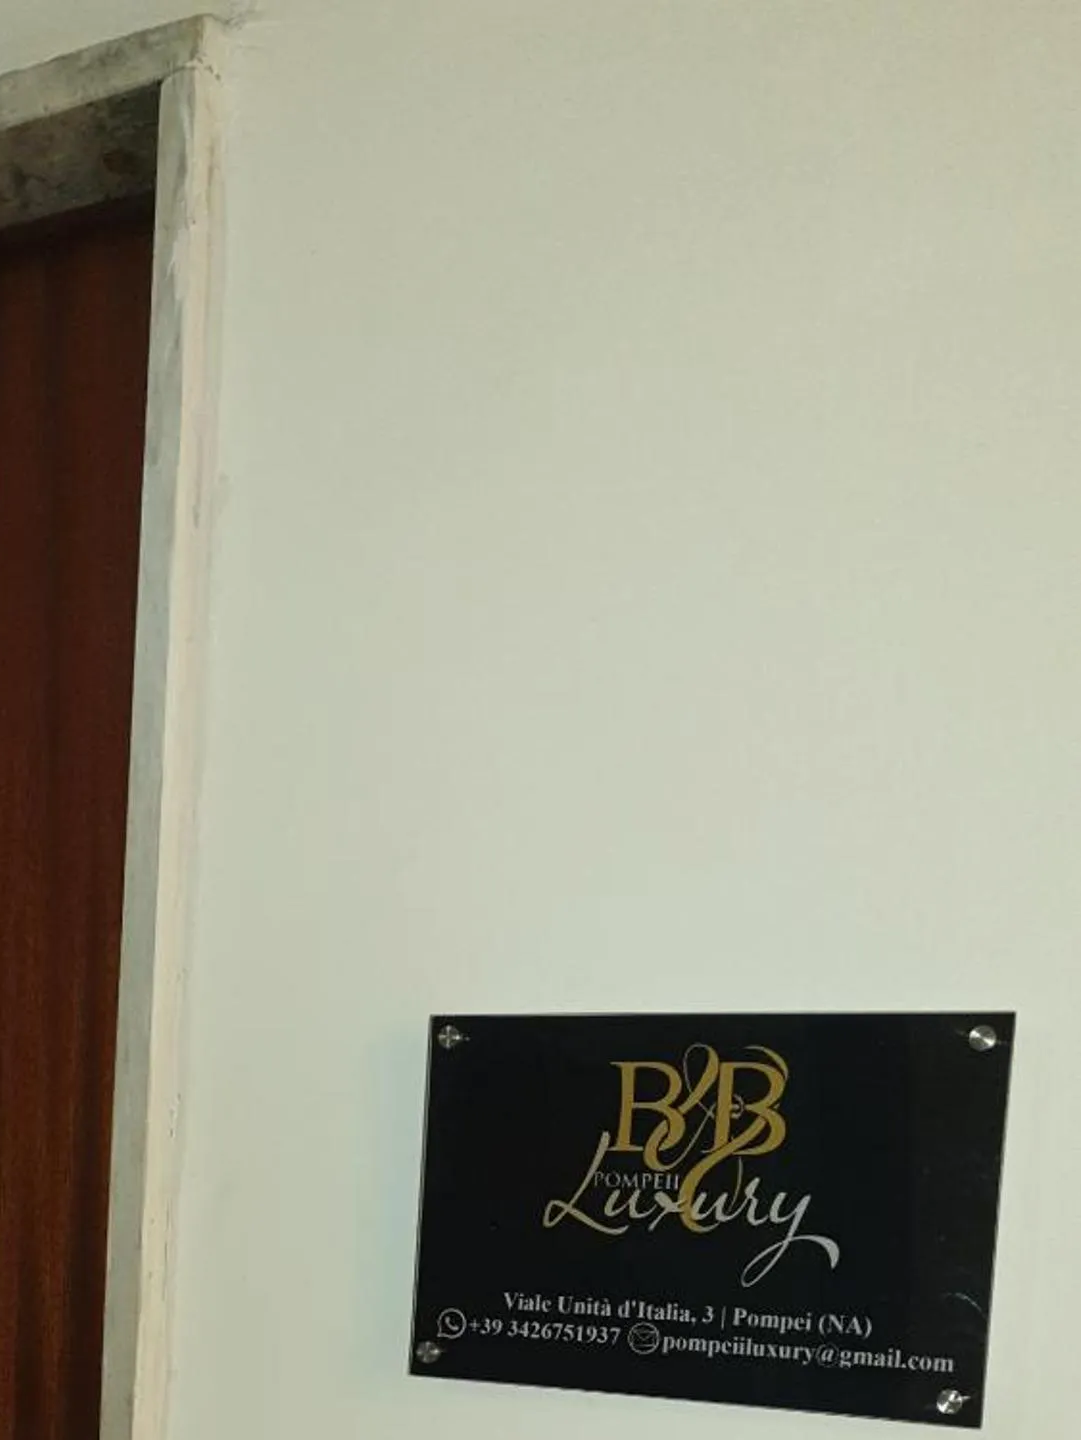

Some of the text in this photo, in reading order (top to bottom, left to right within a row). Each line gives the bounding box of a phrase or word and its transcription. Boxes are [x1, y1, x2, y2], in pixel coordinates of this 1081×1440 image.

[606, 1043, 788, 1172] B&B
[593, 1170, 680, 1191] POMPEII
[543, 1131, 840, 1288] Luxury
[469, 1317, 621, 1346] +39 3426751937
[504, 1292, 552, 1314] Viale
[558, 1296, 612, 1318] Unità
[617, 1300, 697, 1325] d'Italia,
[701, 1305, 714, 1324] 3
[732, 1307, 813, 1334] Pompei
[819, 1314, 873, 1339] (NA)
[662, 1334, 955, 1373] pompeiiluxury@gmail.com
